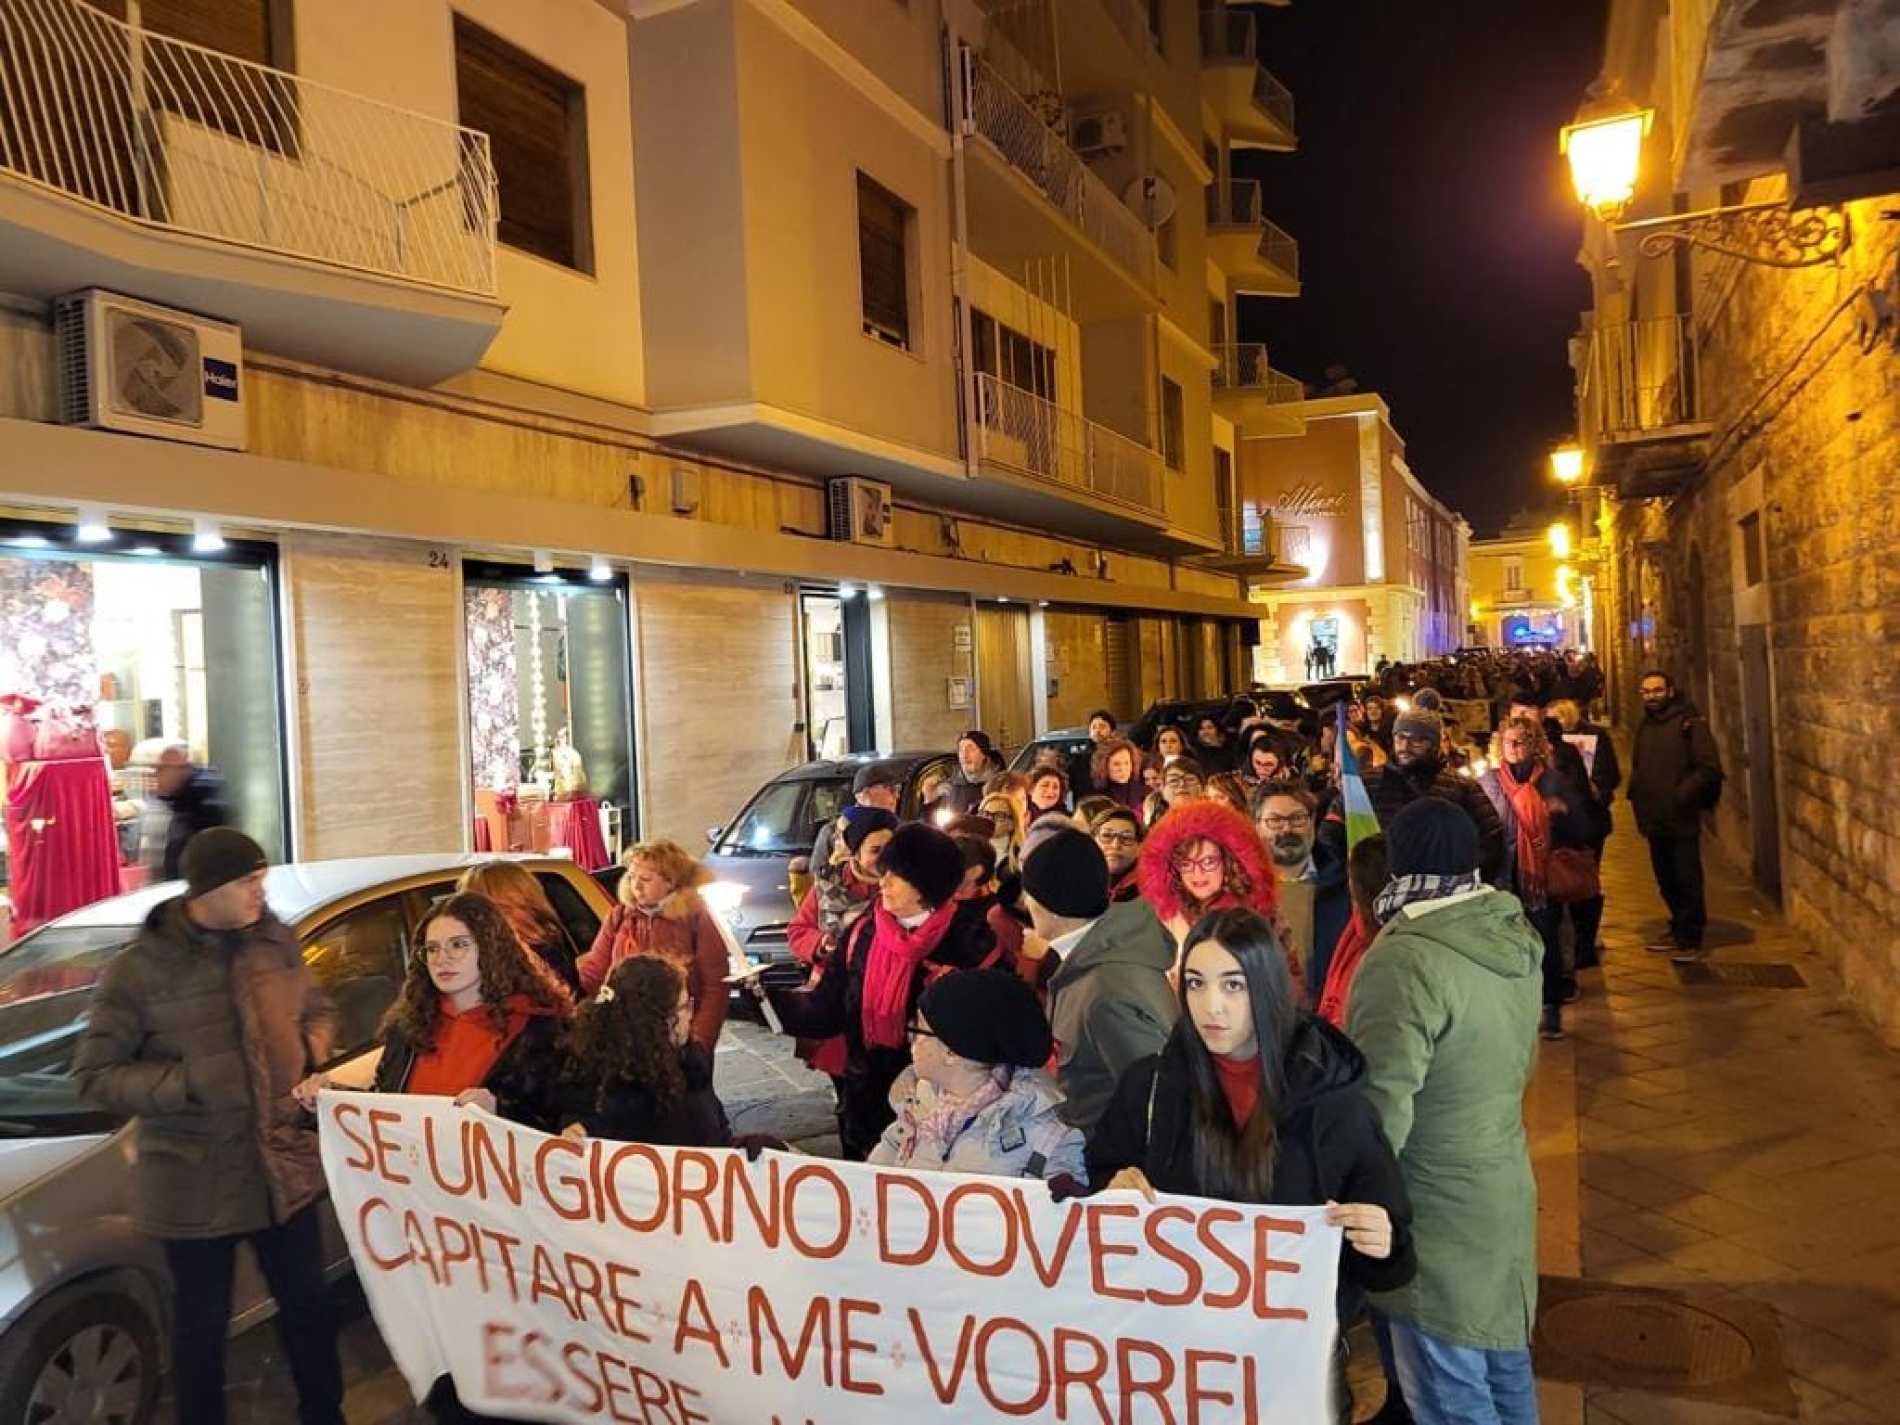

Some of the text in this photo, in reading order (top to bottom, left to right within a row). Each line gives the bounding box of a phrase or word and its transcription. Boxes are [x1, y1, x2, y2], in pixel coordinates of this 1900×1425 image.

[429, 550, 449, 569] 24
[332, 1102, 1308, 1321] SE UN GIORNO DOVESSE
[357, 1196, 1260, 1425] CAPITARE A ME VORREI
[481, 1321, 710, 1425] ESSERE
